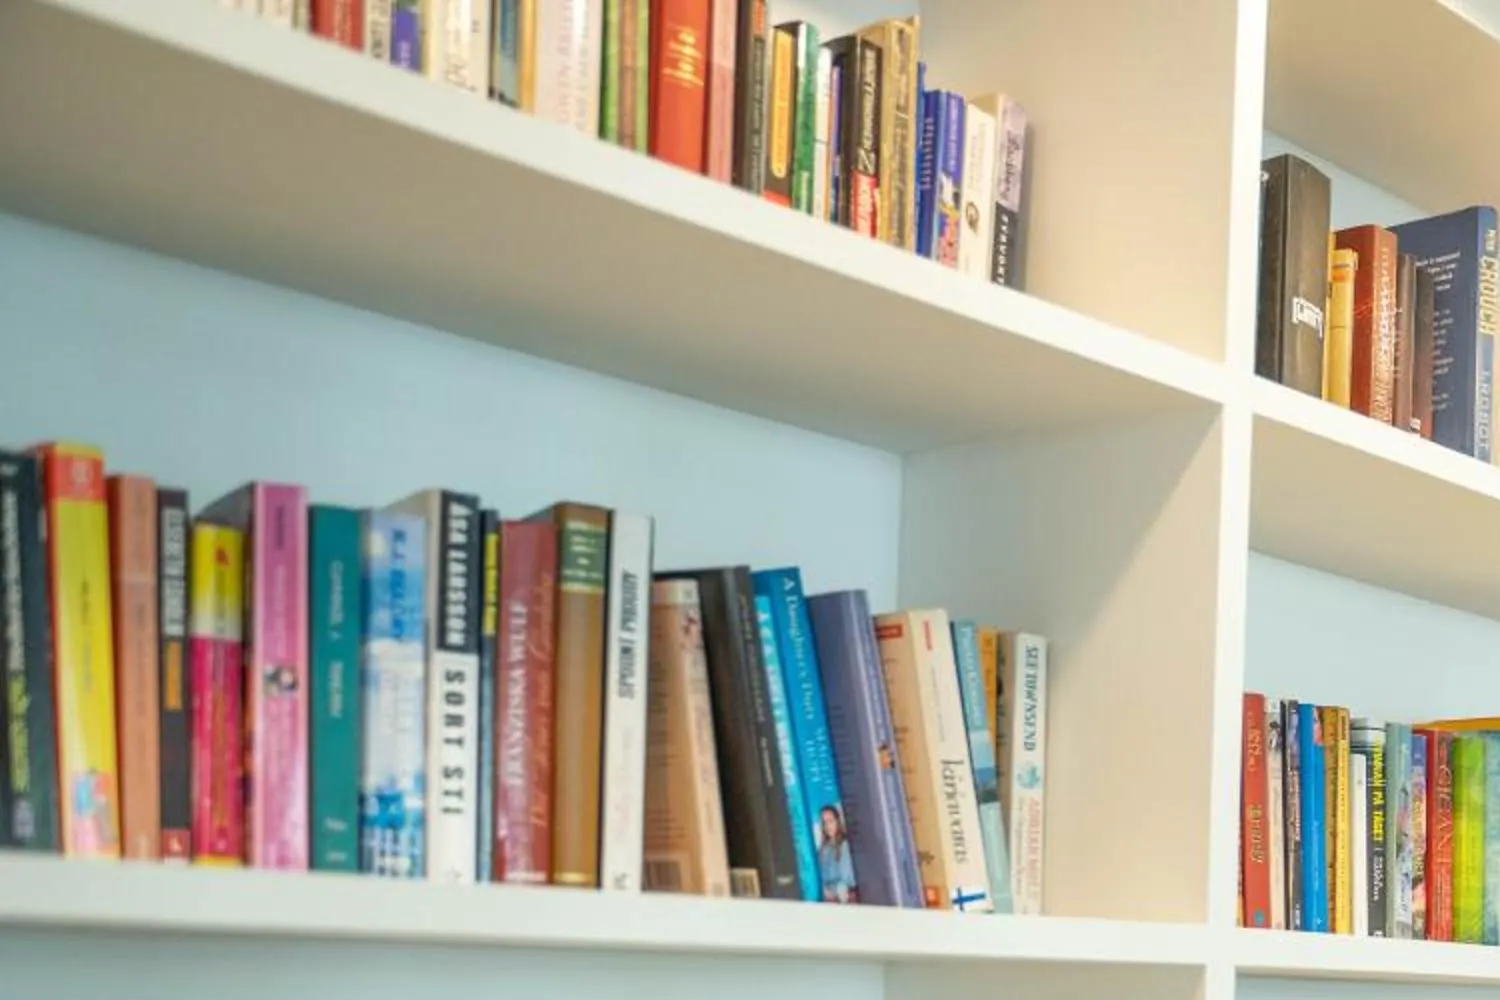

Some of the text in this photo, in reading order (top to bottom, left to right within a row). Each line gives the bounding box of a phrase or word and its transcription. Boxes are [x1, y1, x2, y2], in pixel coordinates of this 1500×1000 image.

[1479, 256, 1499, 335] CROUCH
[445, 501, 473, 647] ÅSA LARSSON
[505, 599, 528, 787] FRANZISKA WULF
[783, 576, 795, 592] A
[798, 683, 815, 721] Duty
[1023, 673, 1038, 752] TOWNSEND
[442, 669, 465, 816] SORT STI
